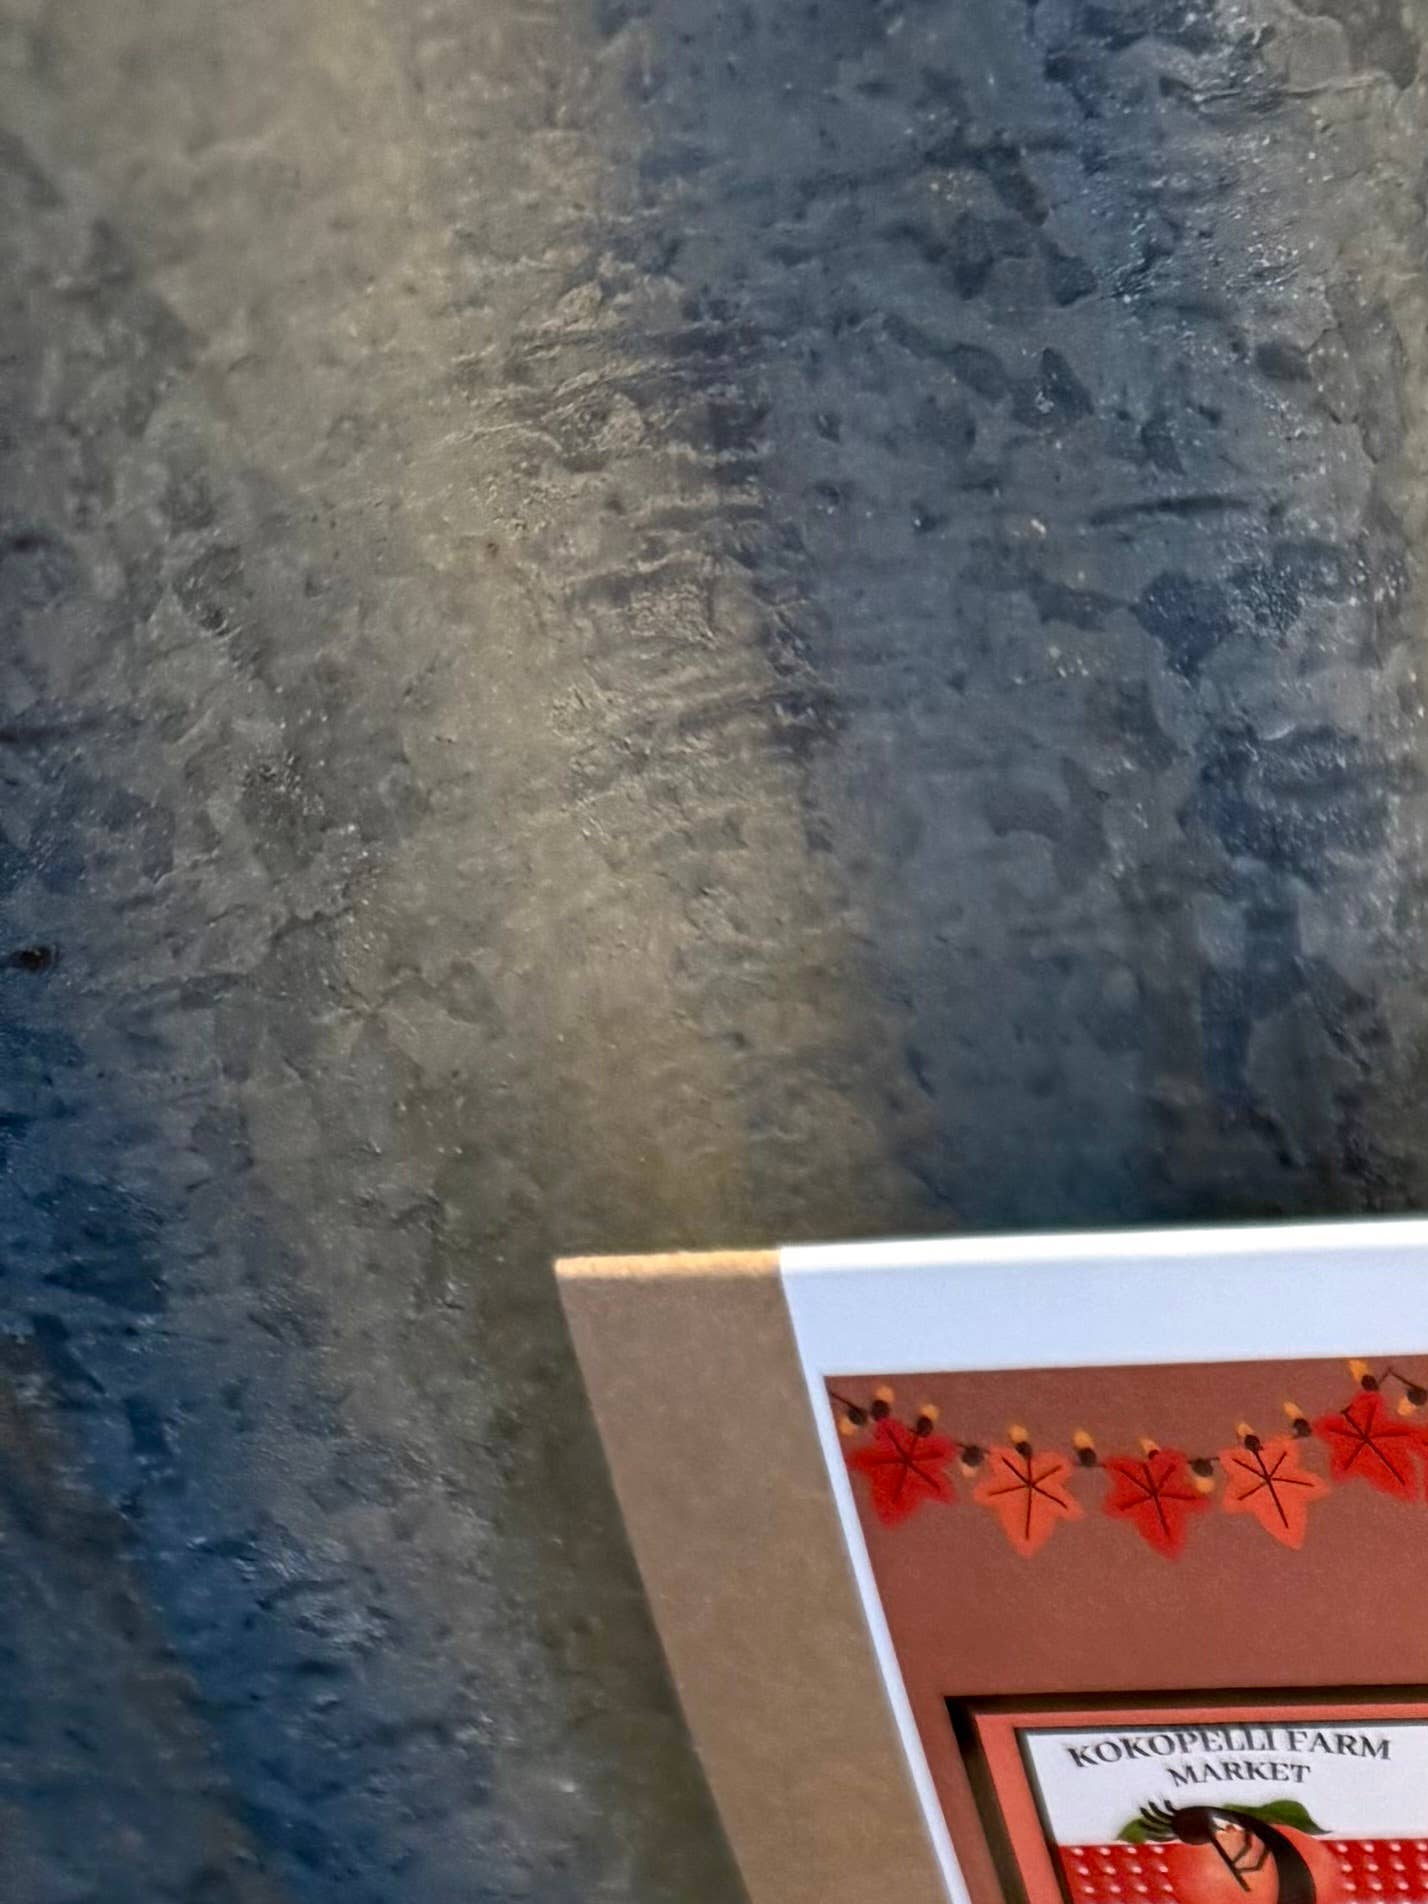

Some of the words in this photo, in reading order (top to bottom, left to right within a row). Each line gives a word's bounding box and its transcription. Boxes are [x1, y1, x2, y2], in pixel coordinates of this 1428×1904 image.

[1066, 1725, 1279, 1770] KOKOPELLI
[1286, 1727, 1392, 1761] FARM
[1166, 1760, 1312, 1787] MARKET
